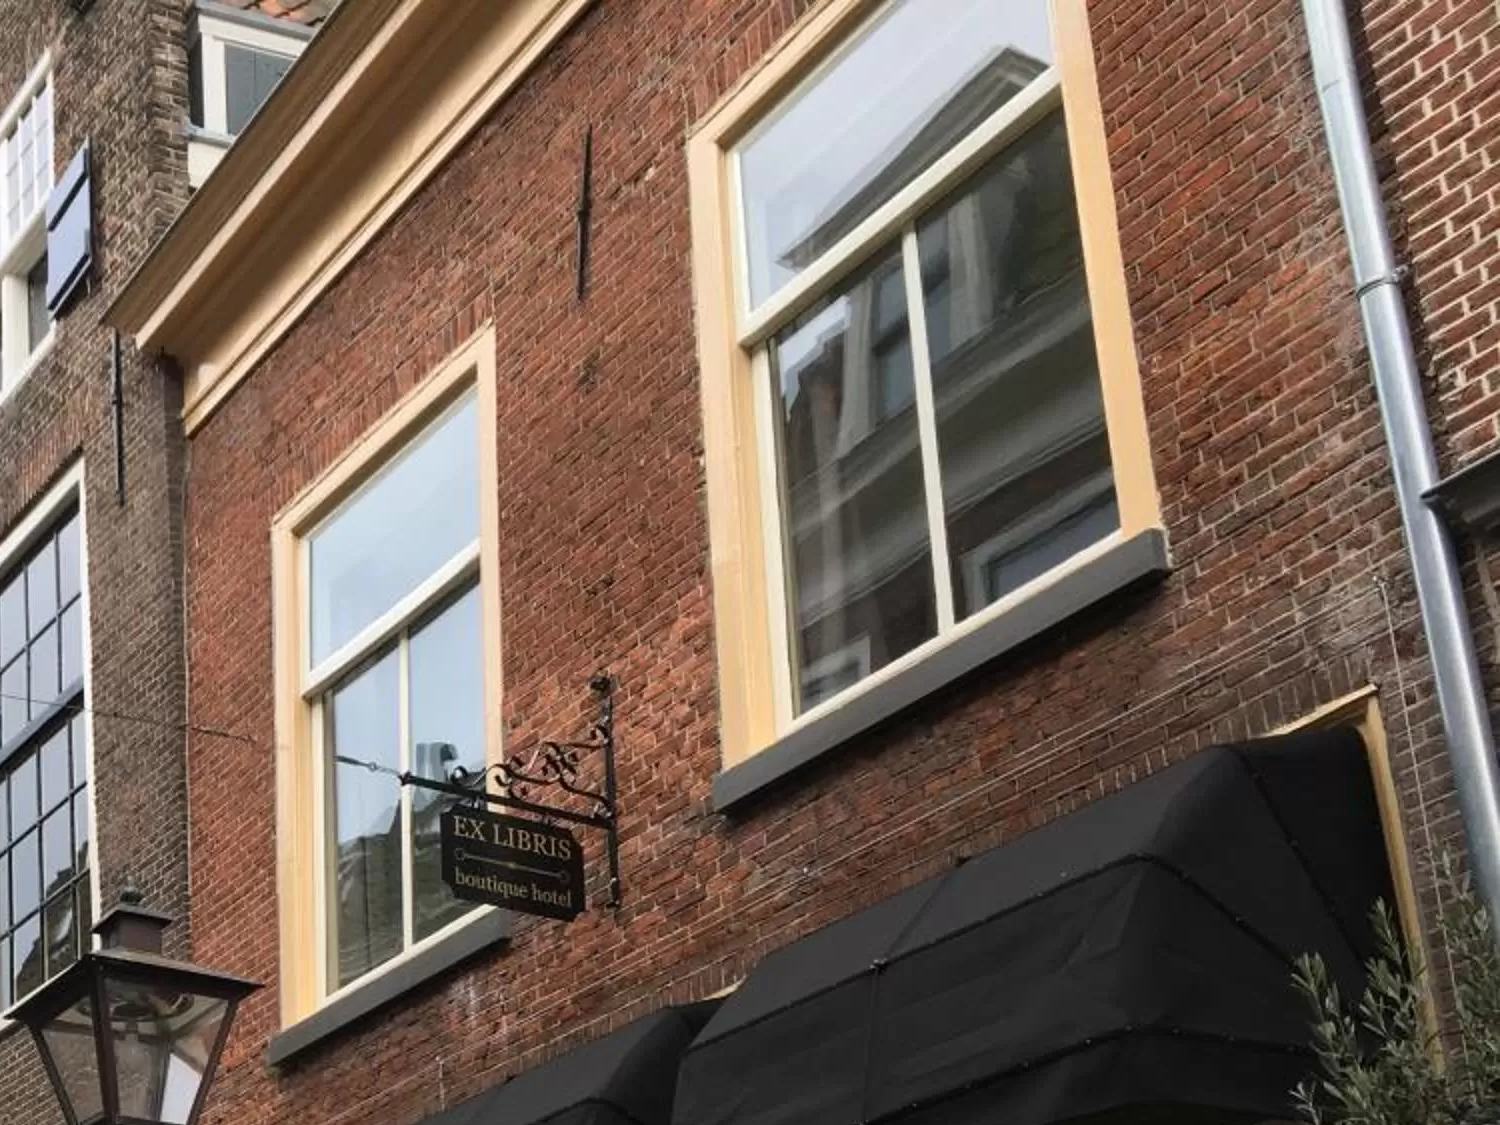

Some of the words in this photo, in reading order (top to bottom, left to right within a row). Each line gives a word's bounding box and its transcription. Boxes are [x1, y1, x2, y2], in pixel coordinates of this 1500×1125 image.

[453, 816, 486, 842] EX
[493, 823, 571, 860] LIBRIS
[455, 866, 528, 898] boutique
[532, 884, 572, 909] hotel
